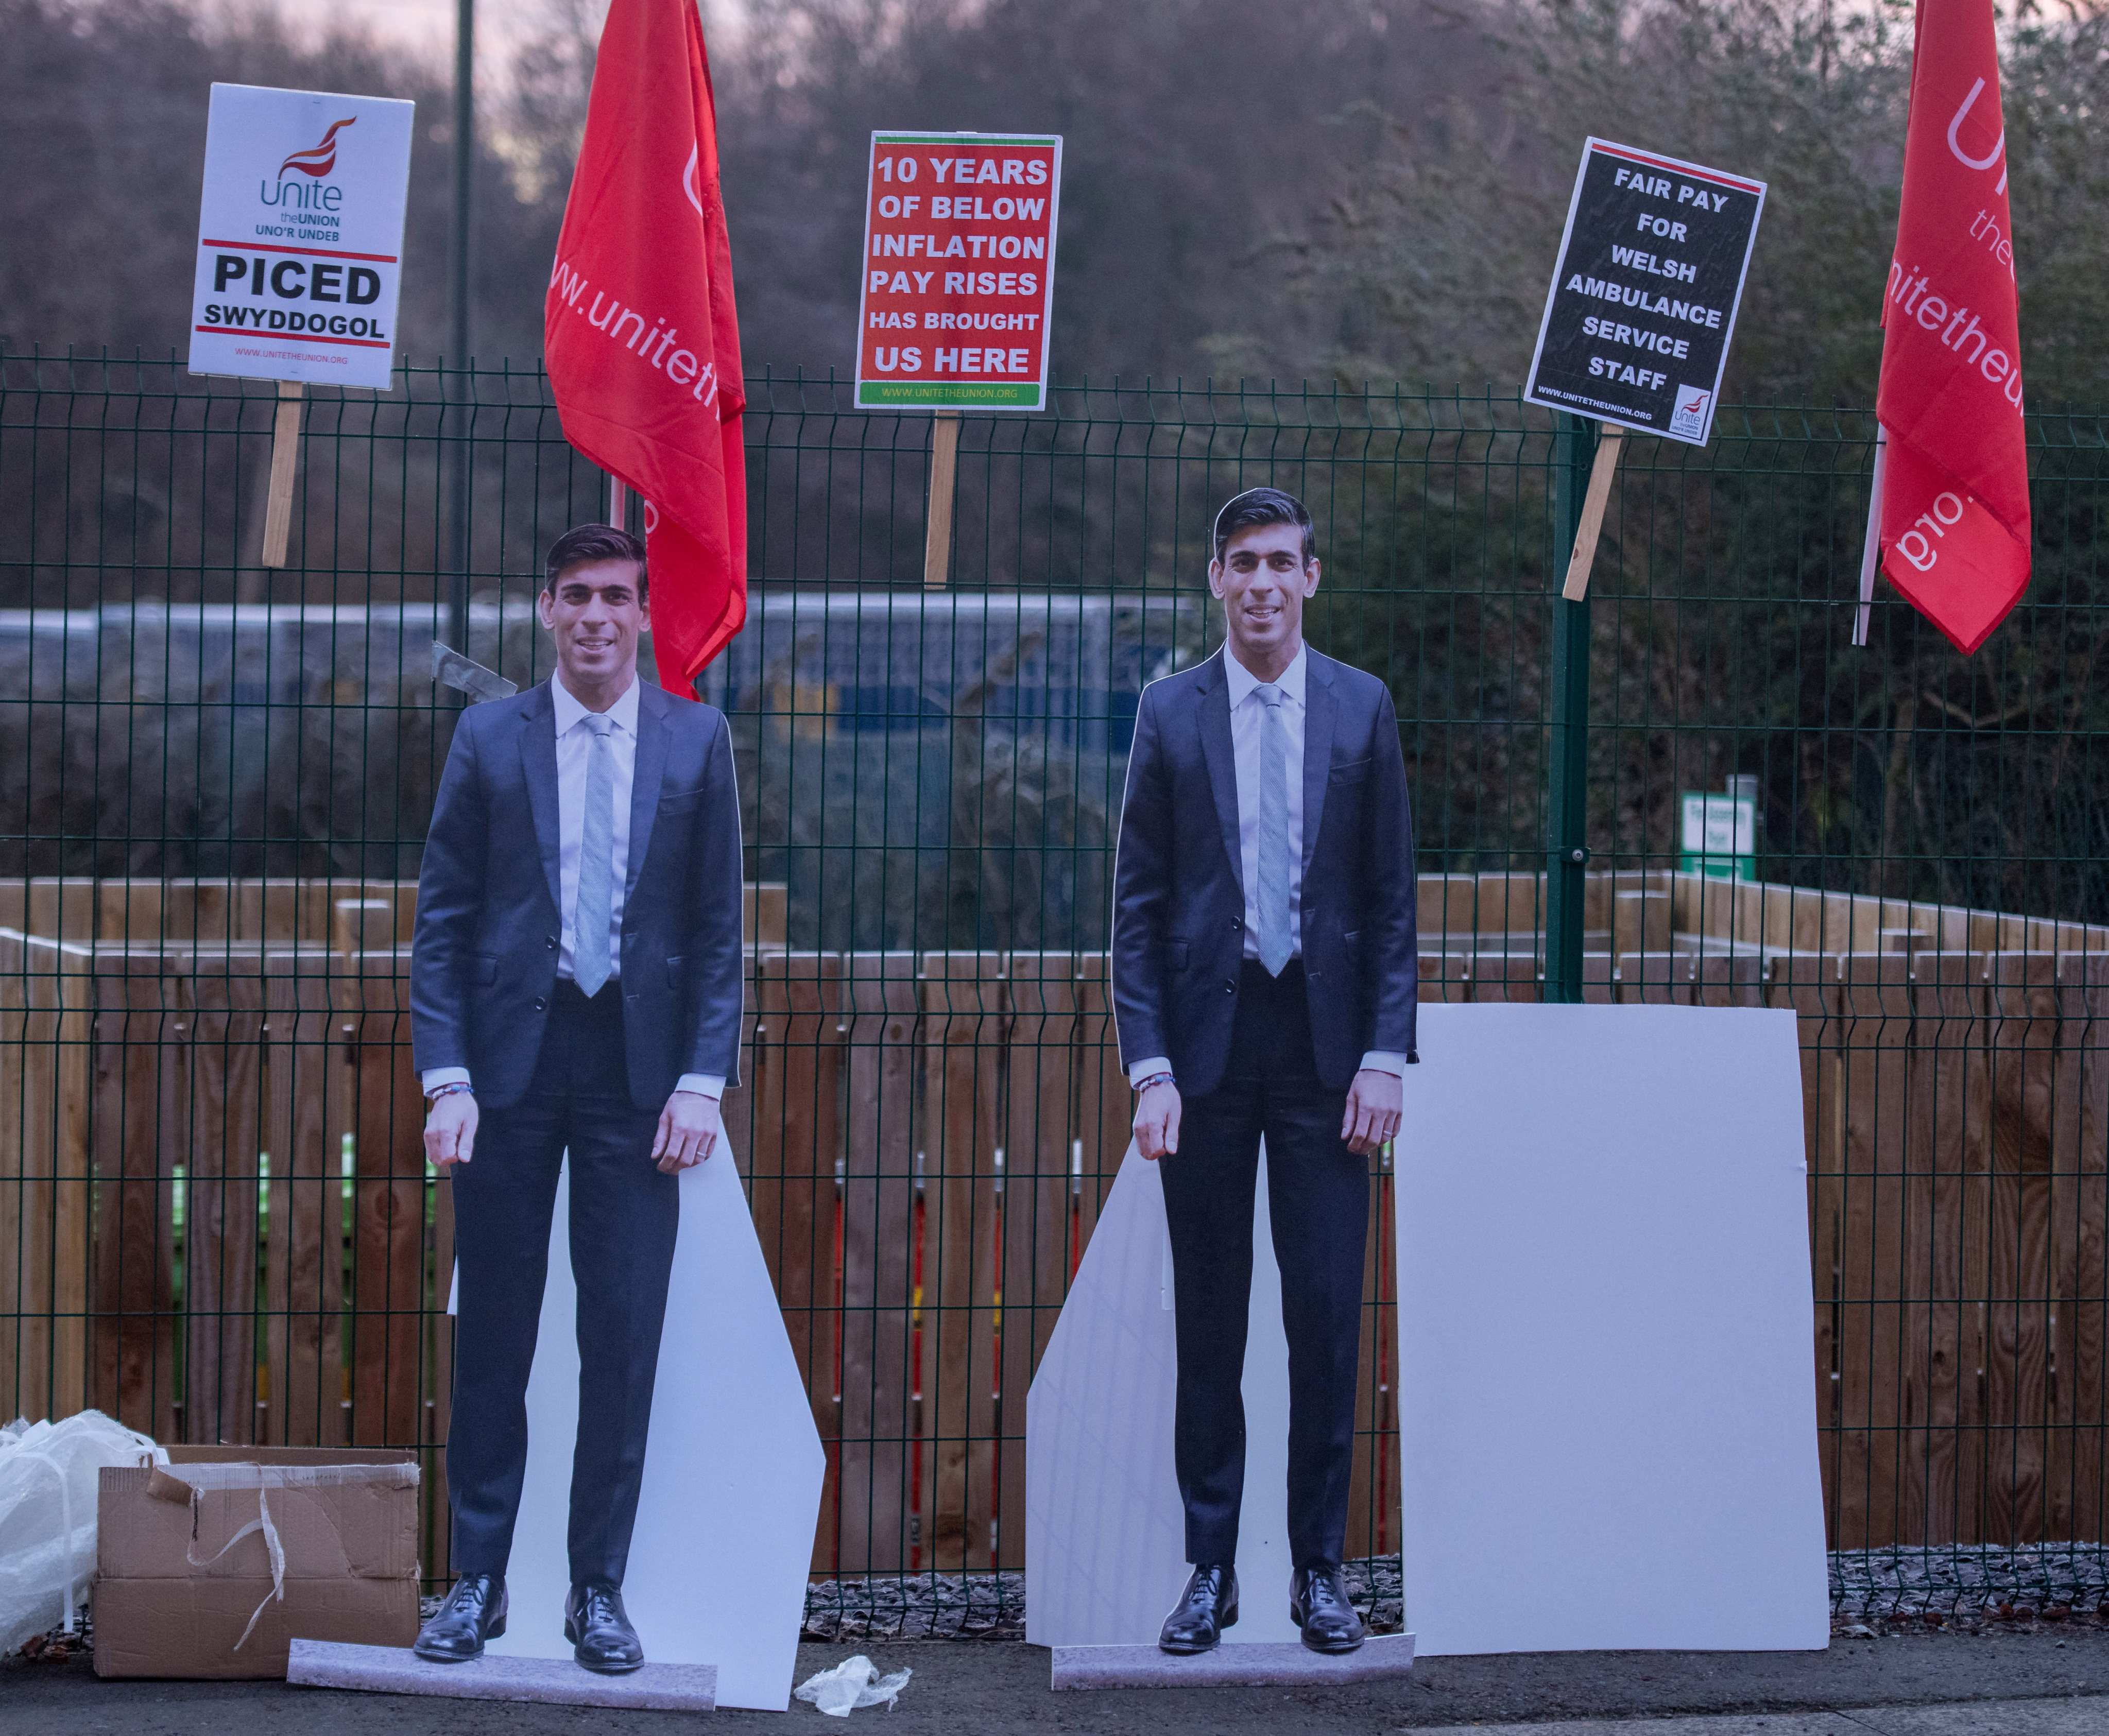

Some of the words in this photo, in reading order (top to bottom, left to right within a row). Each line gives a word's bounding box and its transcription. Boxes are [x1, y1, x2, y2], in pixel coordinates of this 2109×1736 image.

[878, 157, 917, 182] 10
[929, 158, 1048, 185] YEARS
[261, 180, 342, 211] unite
[1614, 167, 1670, 200] FAIR
[1677, 185, 1729, 214] PAY
[281, 212, 339, 227] theUNION
[878, 195, 921, 219] OF
[931, 196, 1045, 221] BELOW
[298, 228, 339, 242] UNDEB
[1637, 213, 1687, 243] FOR
[872, 234, 1045, 260] INFLATION
[1611, 244, 1697, 284] WELSH
[214, 254, 381, 305] PICED
[869, 270, 935, 294] PAY
[944, 272, 1038, 296] RISES
[1565, 273, 1722, 330] AMBULANCE
[204, 304, 385, 339] SWYDDOGOL
[869, 312, 917, 329] HAS
[924, 312, 1039, 331] BROUGHT
[1582, 316, 1690, 360] SERVICE
[235, 348, 348, 365] WWW.UNITETHEUNION.ORG
[875, 347, 922, 372] US
[934, 347, 1028, 373] HERE
[1588, 356, 1667, 391] STAFF
[882, 387, 1018, 399] WWW.UNITETHEUNION.ORG
[1538, 385, 1652, 421] WWW.UNITETHEUNION.ORG
[1675, 411, 1700, 425] unite
